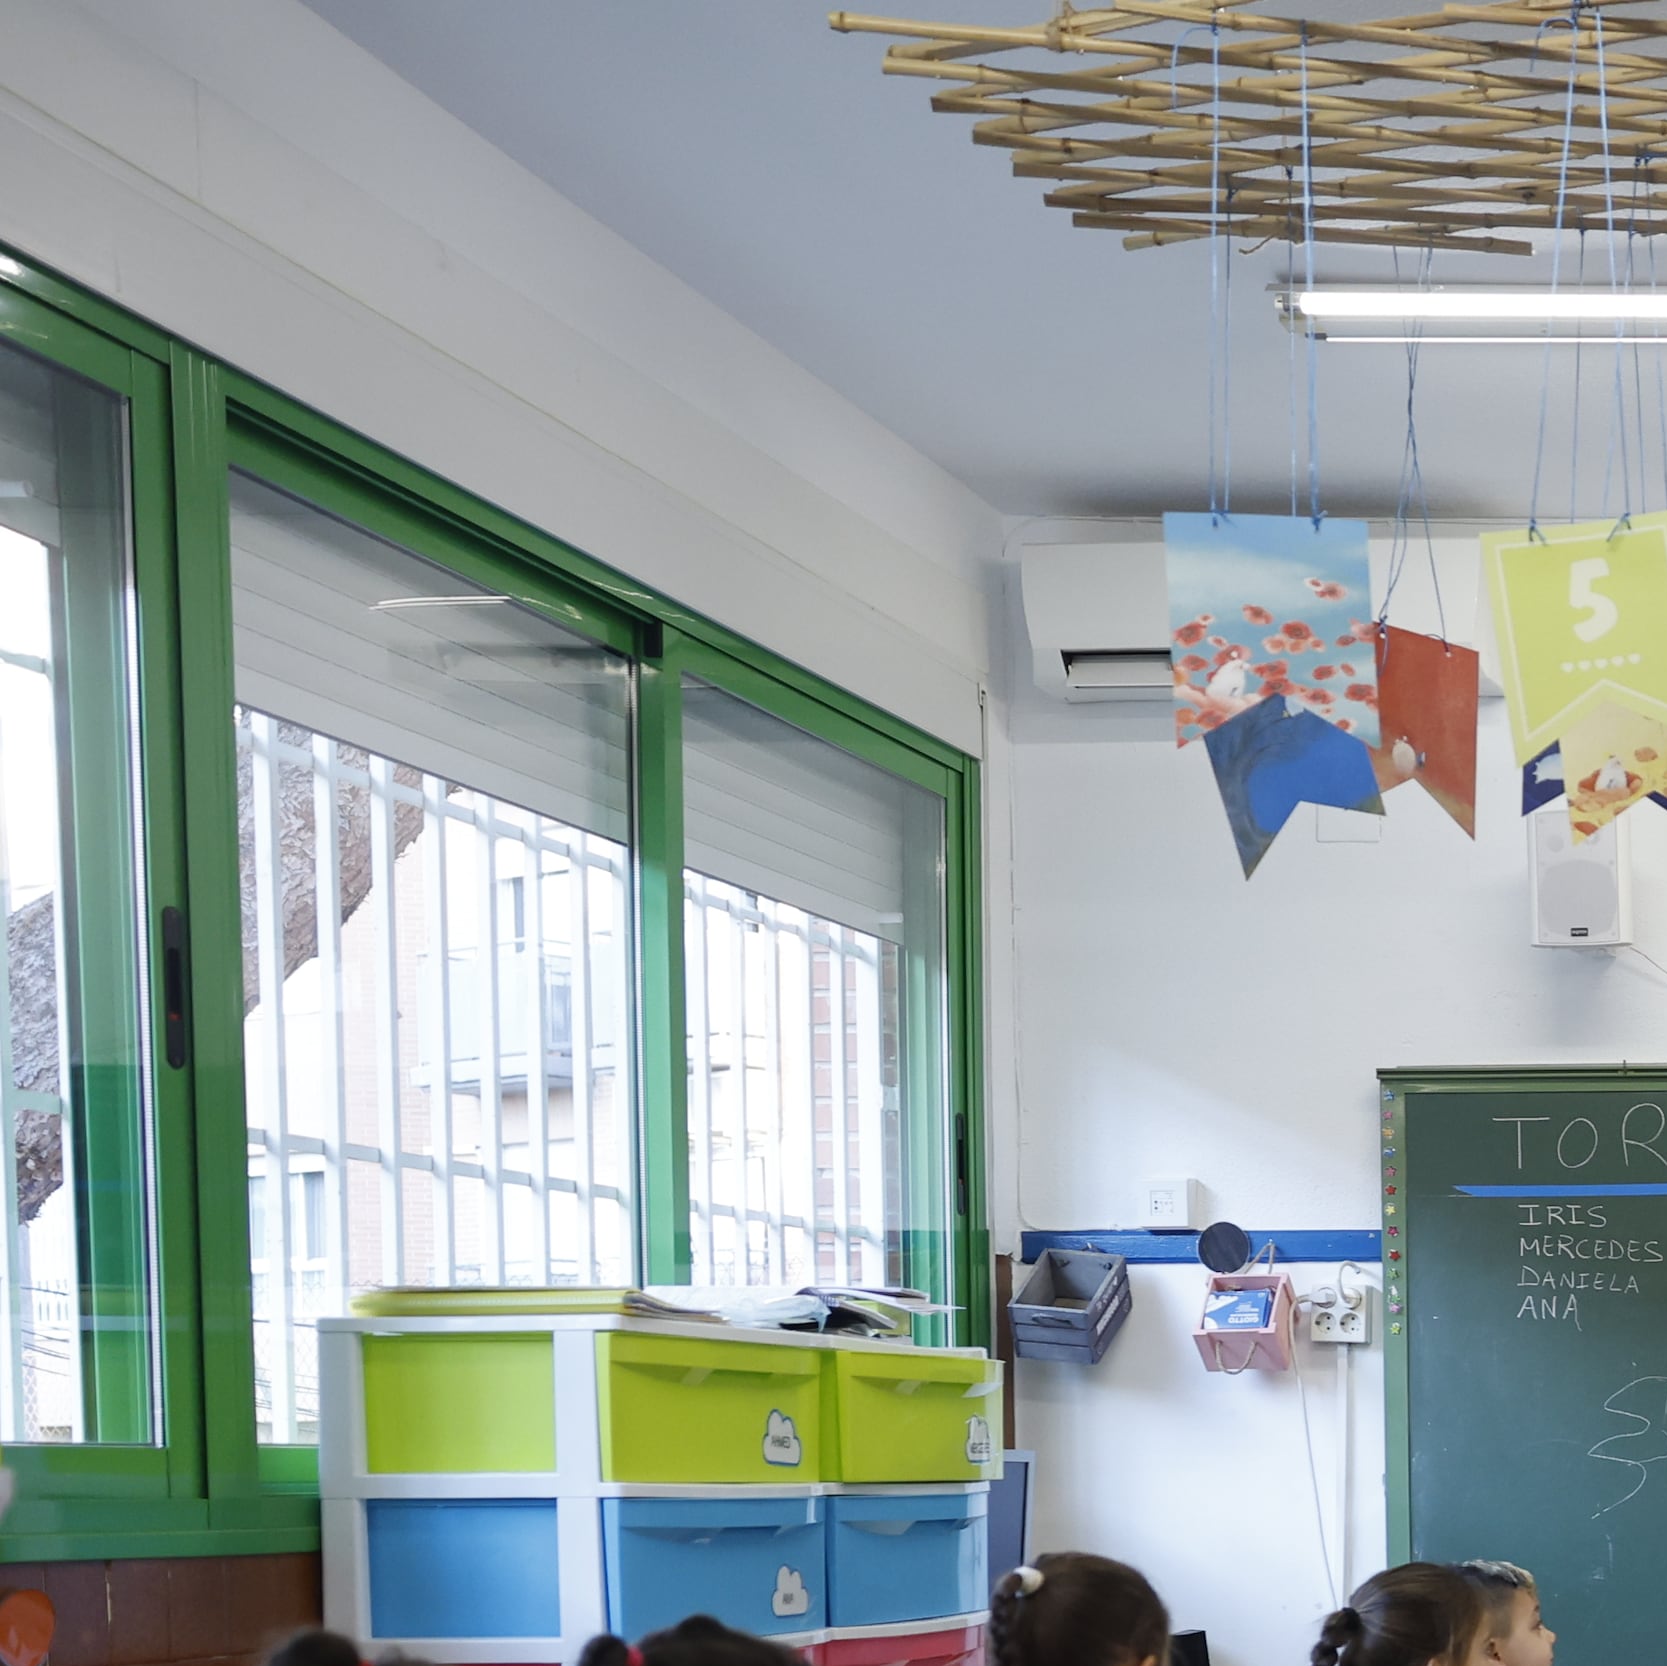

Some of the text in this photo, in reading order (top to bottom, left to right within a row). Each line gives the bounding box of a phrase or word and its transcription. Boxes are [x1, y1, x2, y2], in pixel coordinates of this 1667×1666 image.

[1567, 558, 1619, 644] 5
[1518, 1203, 1608, 1229] IRIS
[1519, 1235, 1664, 1263] MERCEDES
[1516, 1264, 1640, 1294] DANIELA
[1516, 1293, 1582, 1331] ANA
